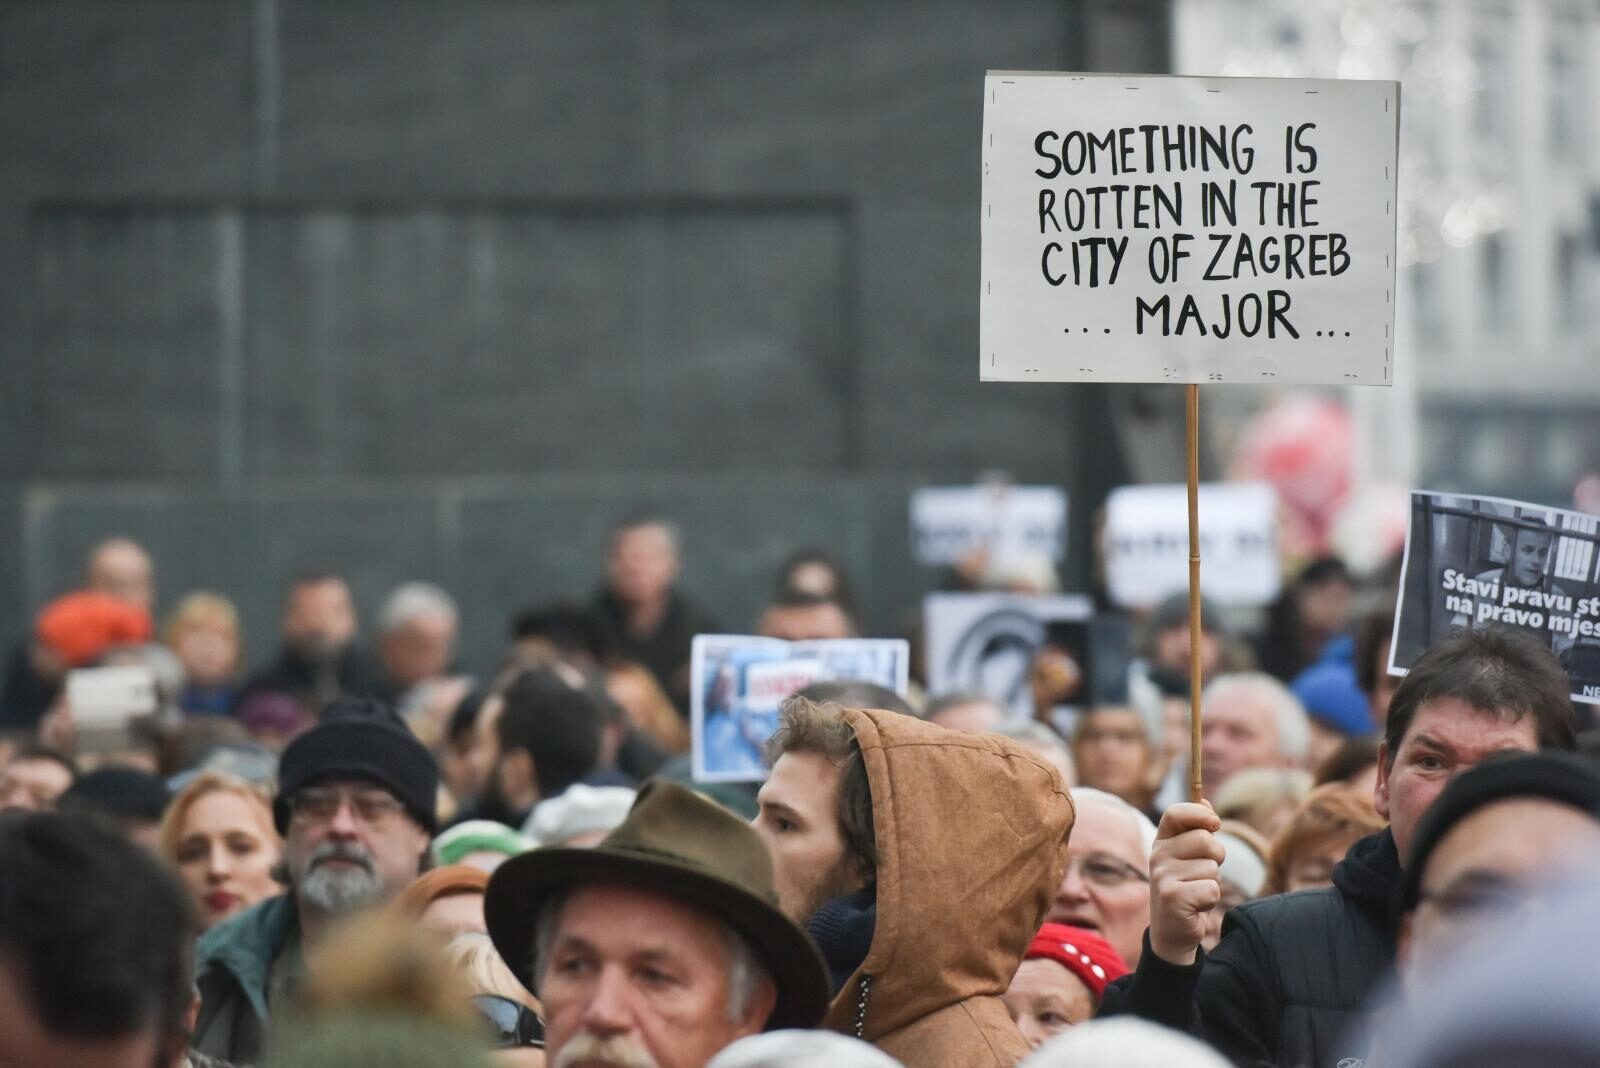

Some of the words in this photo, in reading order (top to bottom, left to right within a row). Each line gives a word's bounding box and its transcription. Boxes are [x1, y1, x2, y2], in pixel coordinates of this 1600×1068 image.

[1034, 123, 1255, 180] SOMETHING
[1285, 122, 1319, 174] IS
[1038, 181, 1183, 234] ROTTEN
[1201, 179, 1237, 228] IN
[1250, 180, 1321, 229] THE
[1041, 235, 1129, 288] CITY
[1148, 233, 1196, 284] OF
[1202, 232, 1352, 281] ZAGREB
[1135, 289, 1301, 340] MAJOR
[1442, 568, 1499, 600] Stavi
[1503, 586, 1573, 612] pravu
[1446, 594, 1473, 615] na
[1477, 600, 1544, 628] pravo
